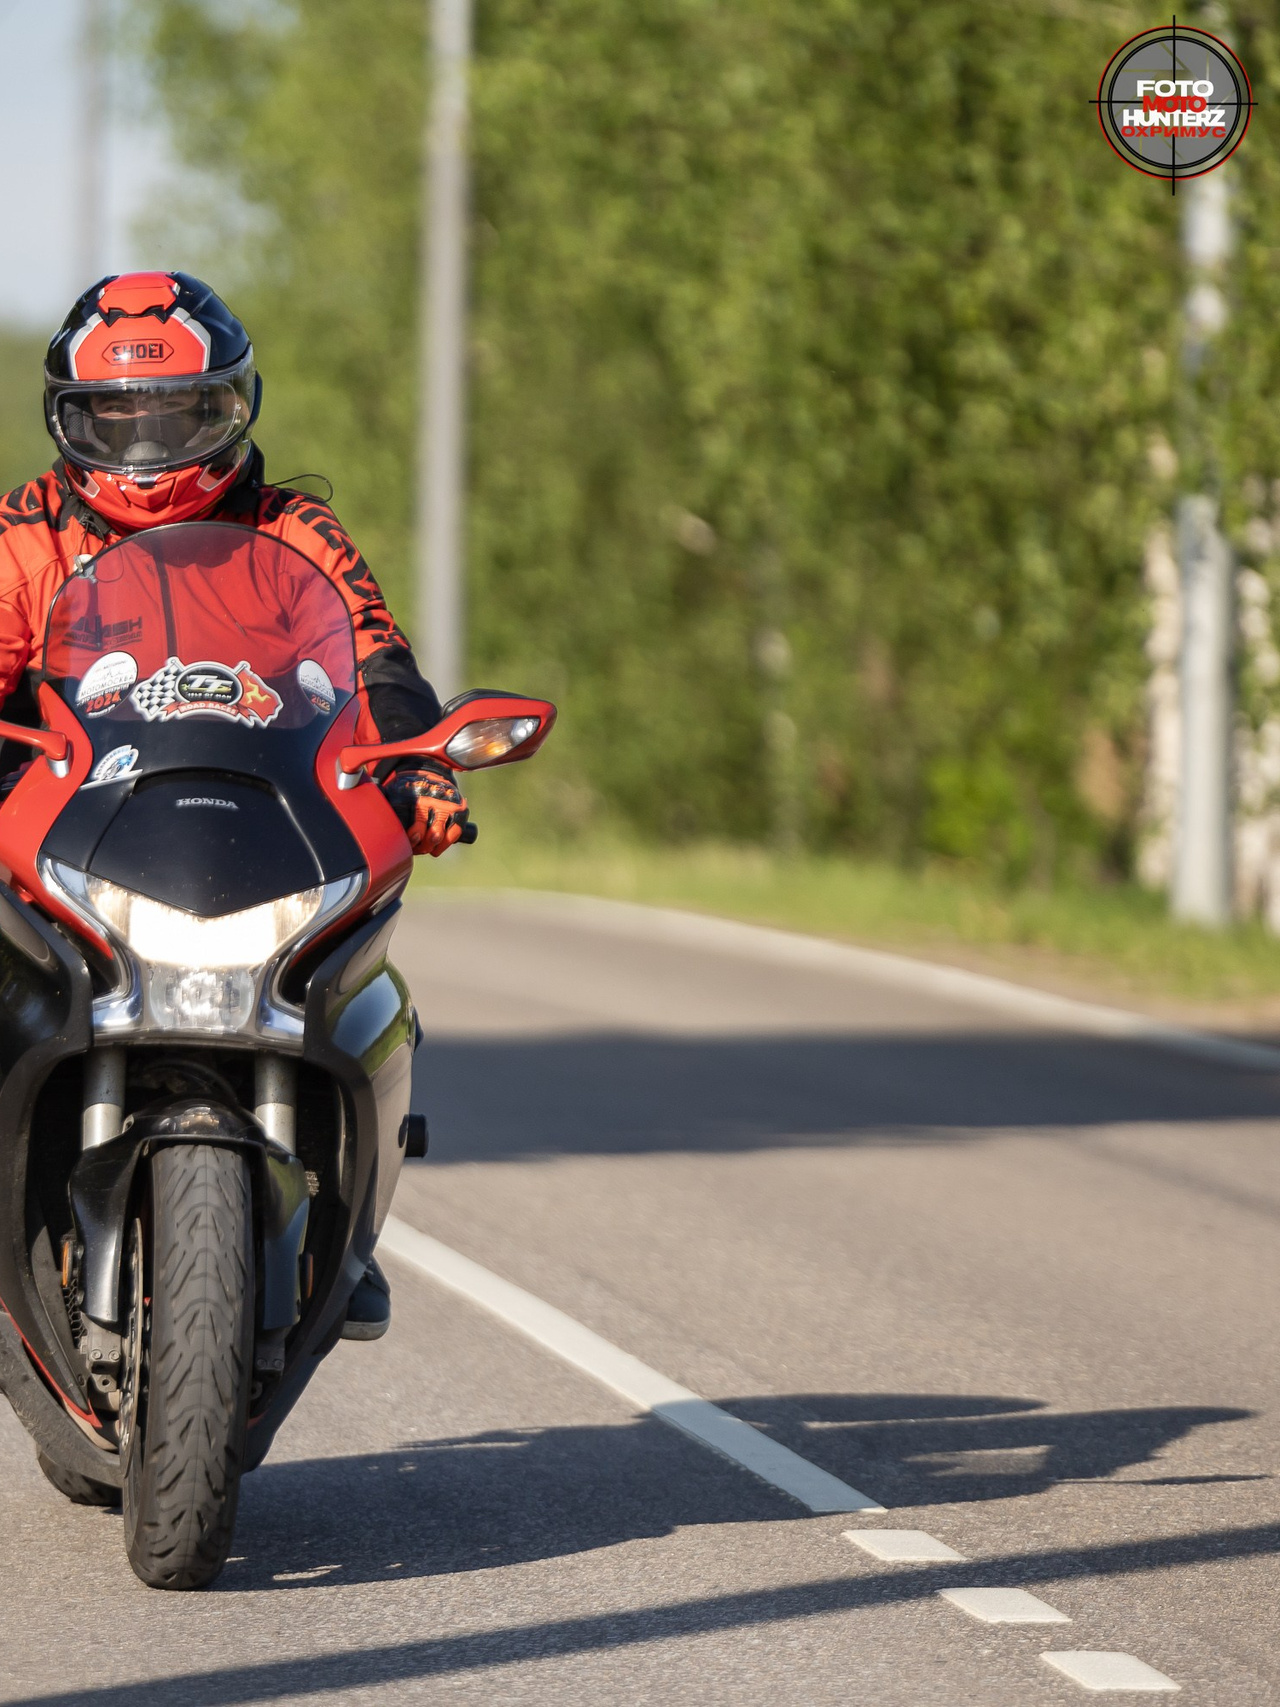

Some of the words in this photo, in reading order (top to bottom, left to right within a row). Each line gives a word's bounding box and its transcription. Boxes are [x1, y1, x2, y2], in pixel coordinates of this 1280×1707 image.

[112, 343, 164, 361] SHOEI
[187, 674, 234, 692] TT
[85, 689, 122, 713] 2024
[180, 702, 206, 712] ROAD
[208, 702, 237, 714] RACES
[176, 797, 239, 810] HONDA
